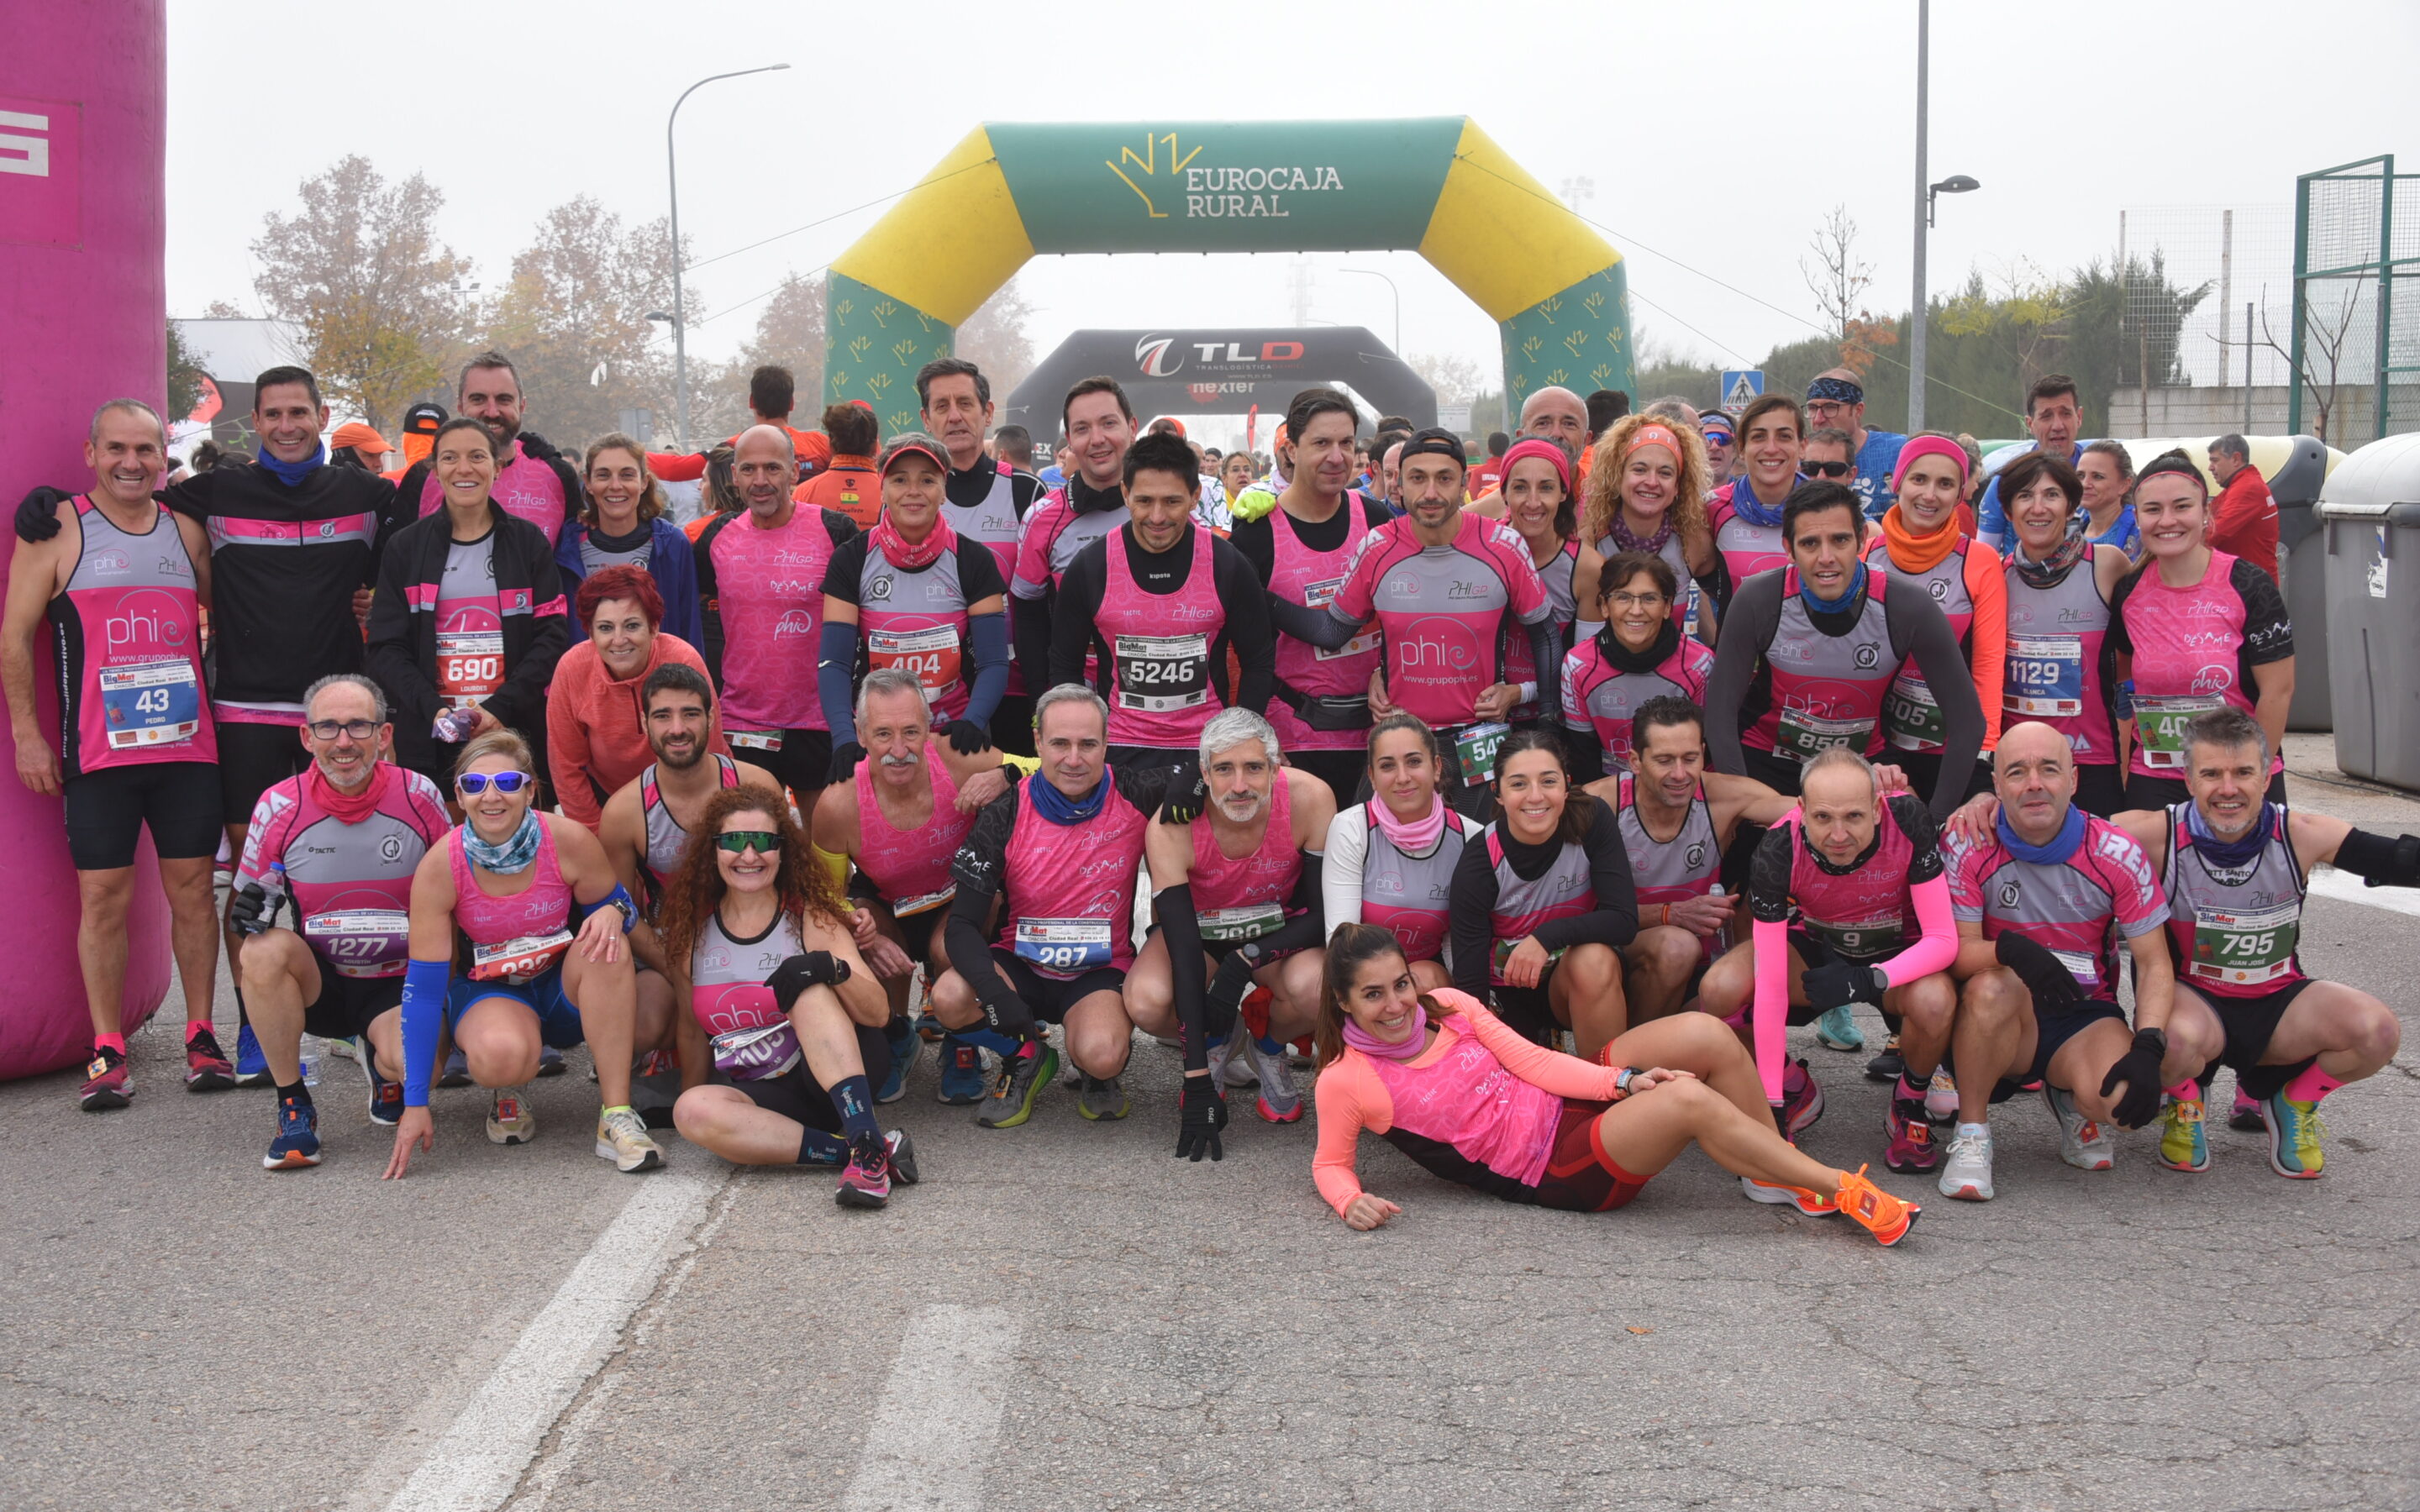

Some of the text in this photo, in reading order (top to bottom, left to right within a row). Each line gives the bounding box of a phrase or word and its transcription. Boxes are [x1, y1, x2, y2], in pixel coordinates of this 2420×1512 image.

[1186, 167, 1344, 192] EUROCAJA
[1187, 196, 1289, 218] RURAL
[1193, 342, 1304, 362] TLD
[1196, 363, 1272, 371] TRANSLOGÍSTICA
[1307, 588, 1334, 599] BigMat
[871, 637, 898, 648] BigMat
[1118, 642, 1147, 651] BigMat
[448, 658, 497, 681] 690
[891, 654, 941, 675] 404
[1130, 660, 1194, 684] 5246
[103, 673, 134, 683] BigMat
[1403, 674, 1478, 685] www.grupophi.es
[2010, 660, 2060, 685] 1129
[135, 688, 170, 713] 43
[2225, 869, 2251, 877] SANTO
[308, 919, 341, 928] BigMat
[2200, 913, 2235, 923] BigMat
[328, 937, 388, 956] 1277
[1843, 932, 1860, 947] 9
[2221, 932, 2275, 956] 795
[476, 944, 508, 957] BigMat
[1039, 947, 1088, 968] 287
[2249, 958, 2266, 966] JOSÉ
